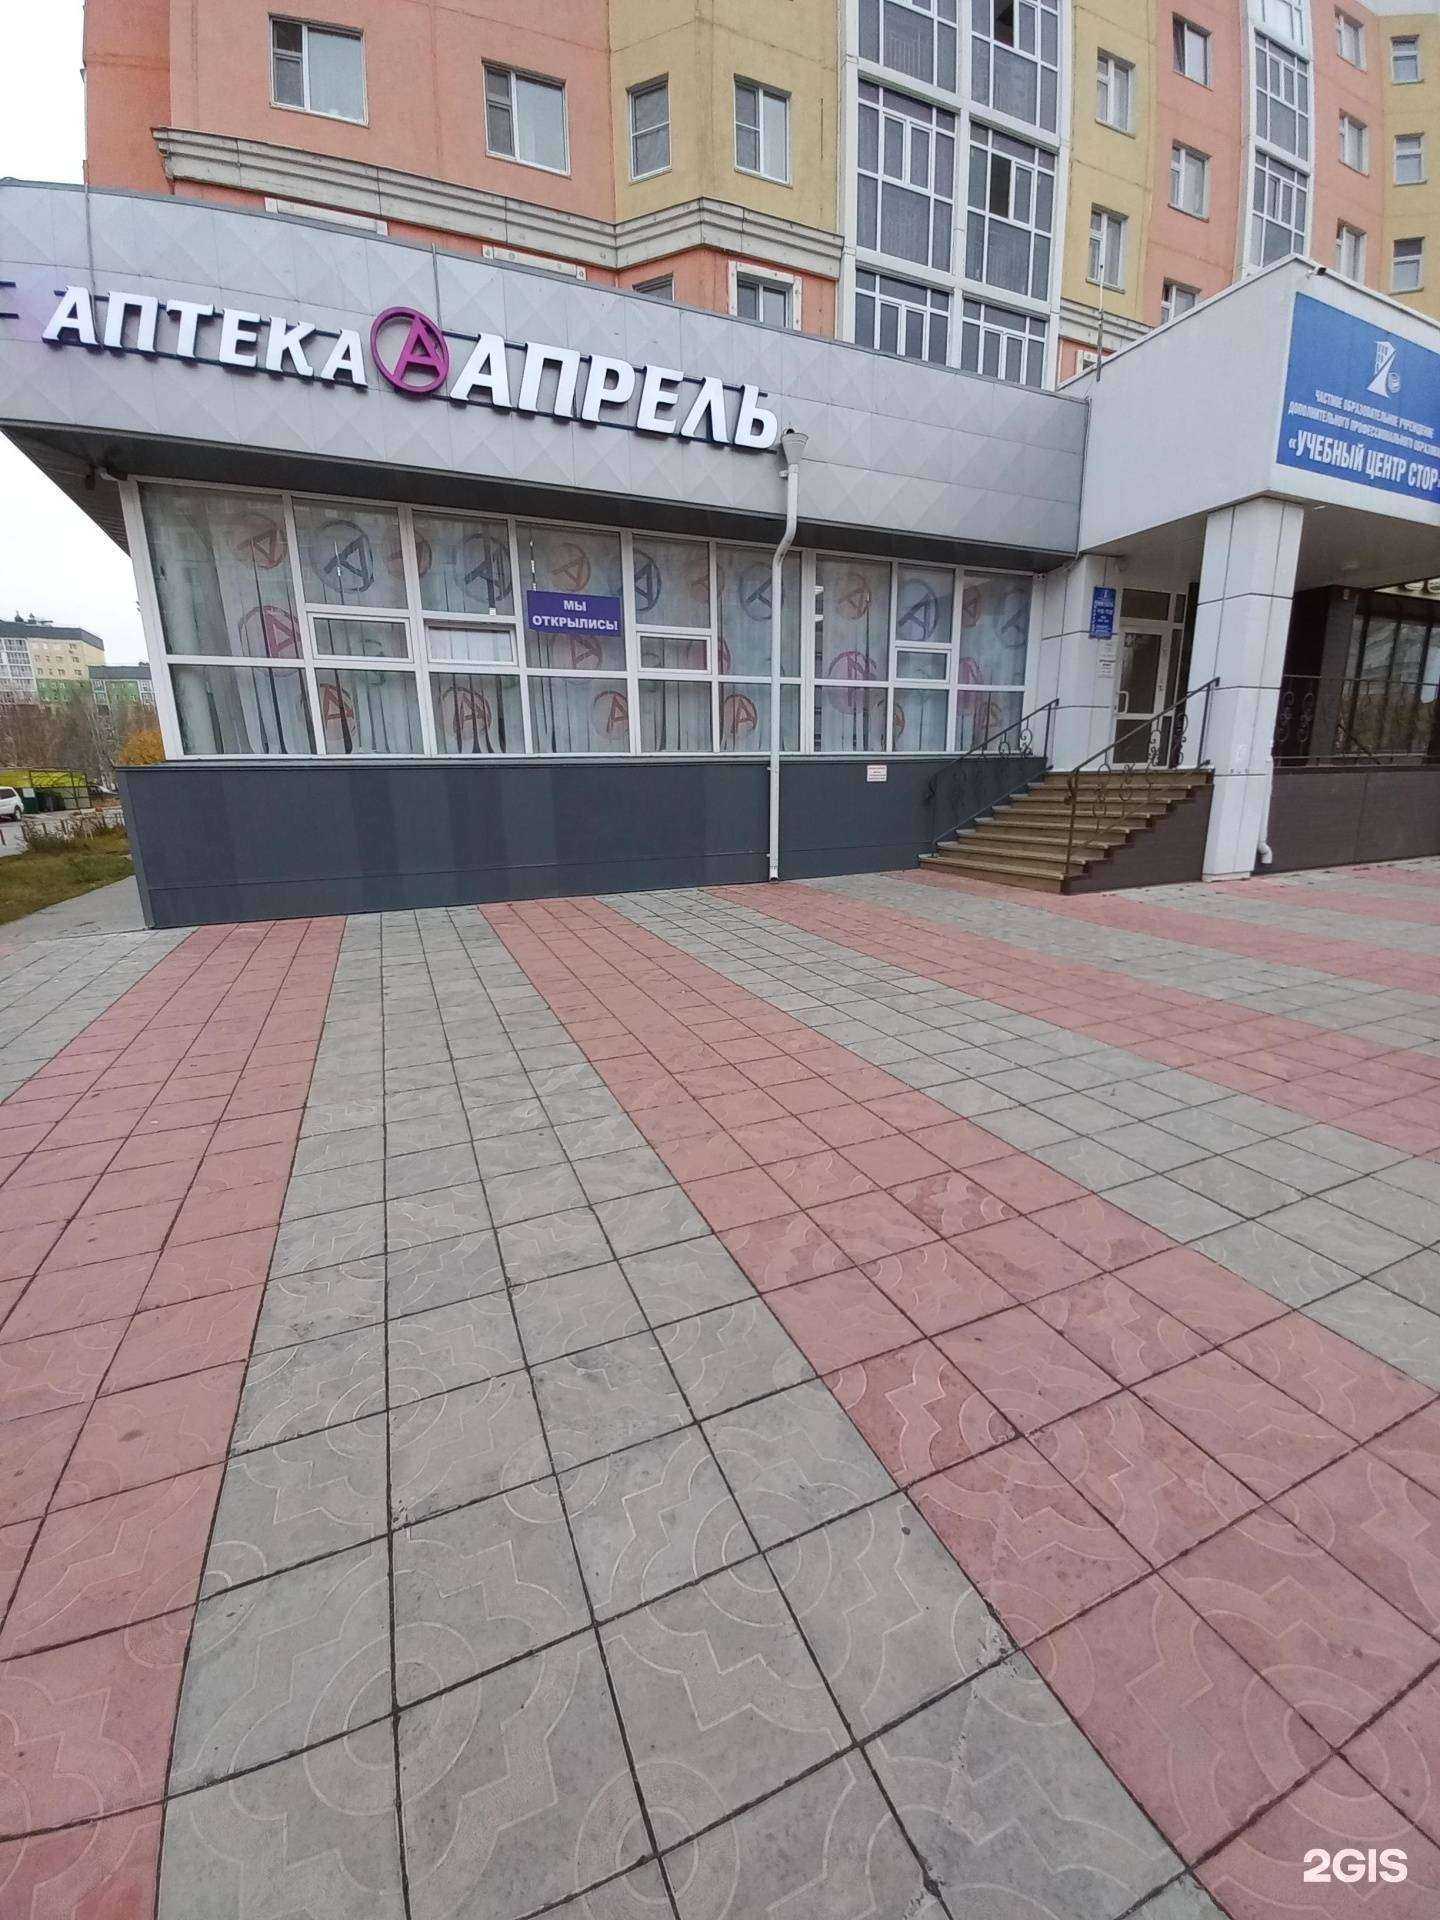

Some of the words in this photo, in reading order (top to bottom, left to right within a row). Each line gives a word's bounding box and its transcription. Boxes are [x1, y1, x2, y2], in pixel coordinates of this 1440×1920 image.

[42, 285, 367, 388] АПТЕКА
[449, 333, 778, 449] АПРЕЛЬ
[1288, 430, 1365, 471] «УЧЕБНЫЙ
[1365, 450, 1406, 483] ЦЕНТР
[532, 615, 619, 631] ОТКРЫЛИСЬ!
[563, 600, 587, 612] МЫ
